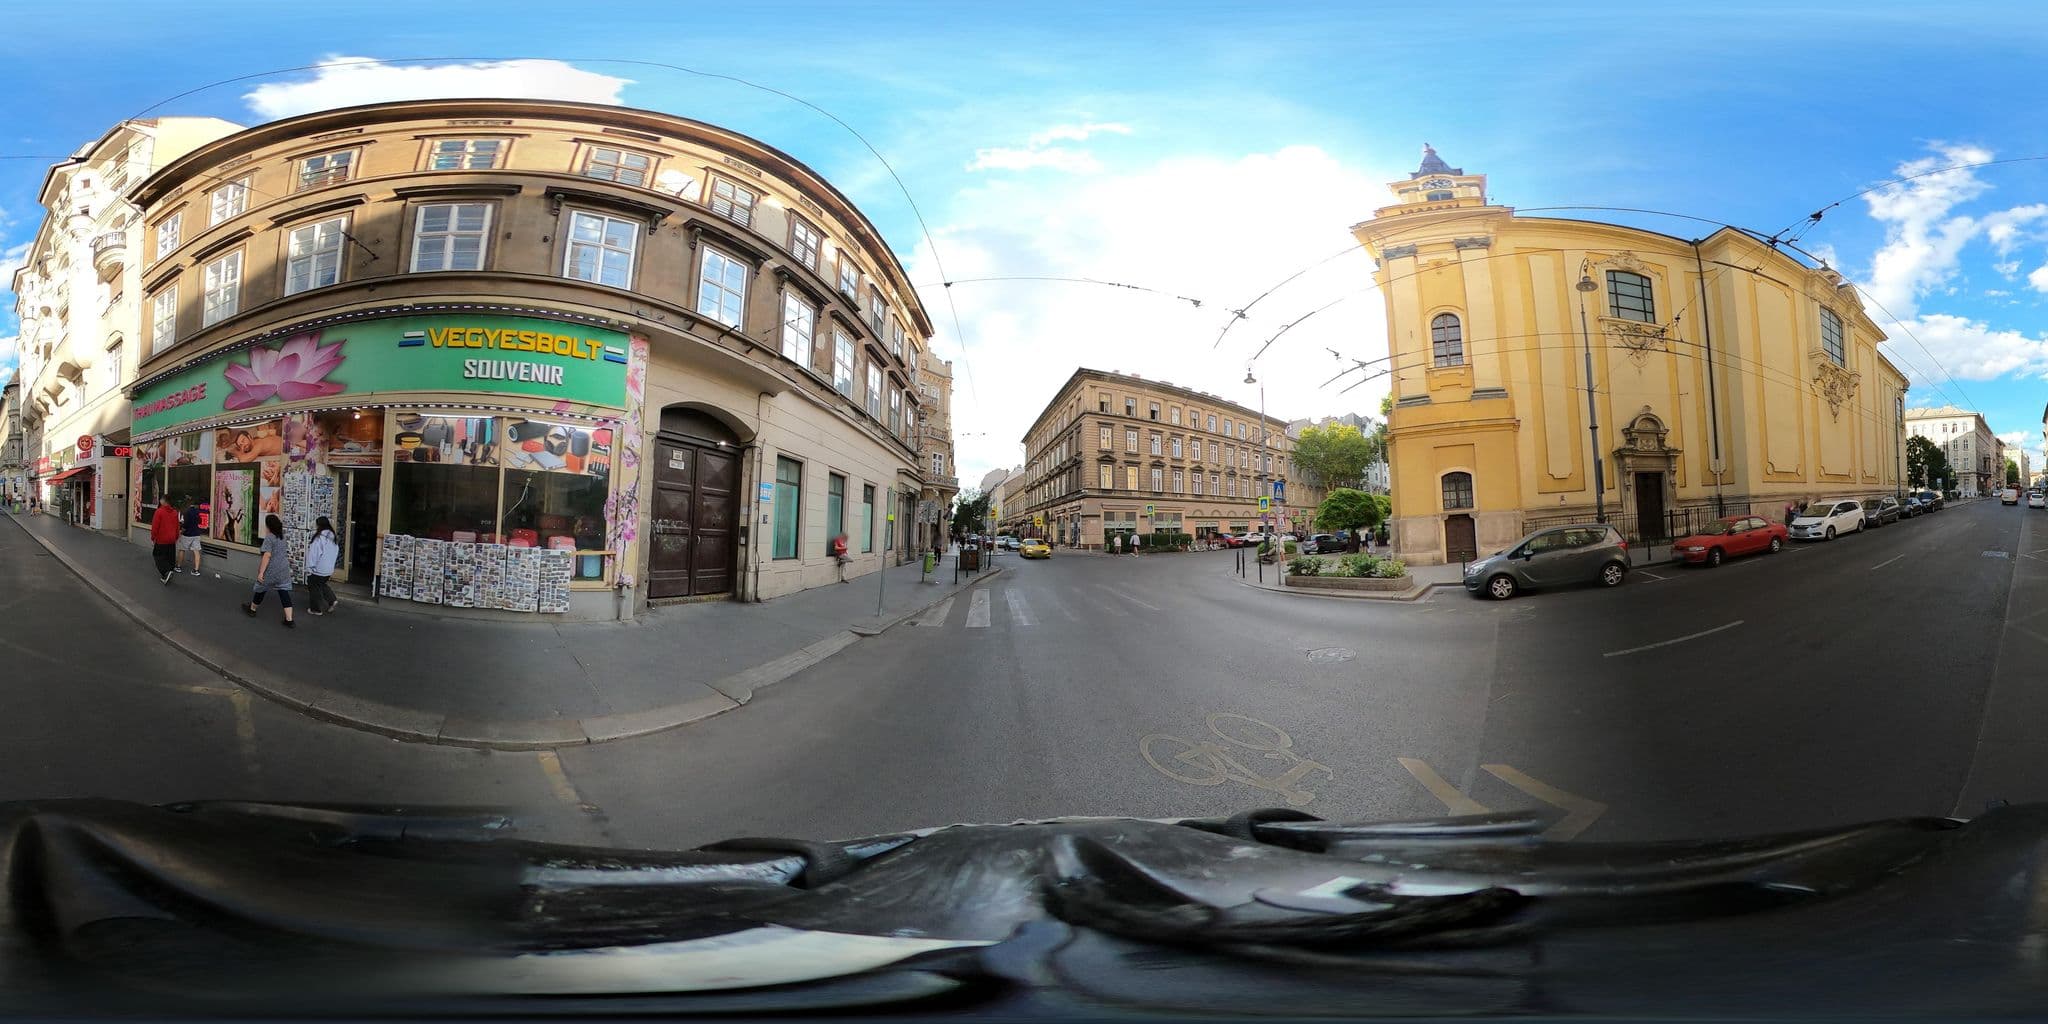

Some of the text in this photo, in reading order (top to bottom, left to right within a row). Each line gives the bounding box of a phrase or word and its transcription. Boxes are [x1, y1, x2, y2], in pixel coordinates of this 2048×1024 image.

[429, 327, 603, 360] VEGYESBOLT
[464, 359, 563, 385] SOUVENIR
[153, 383, 206, 412] MASSAGE
